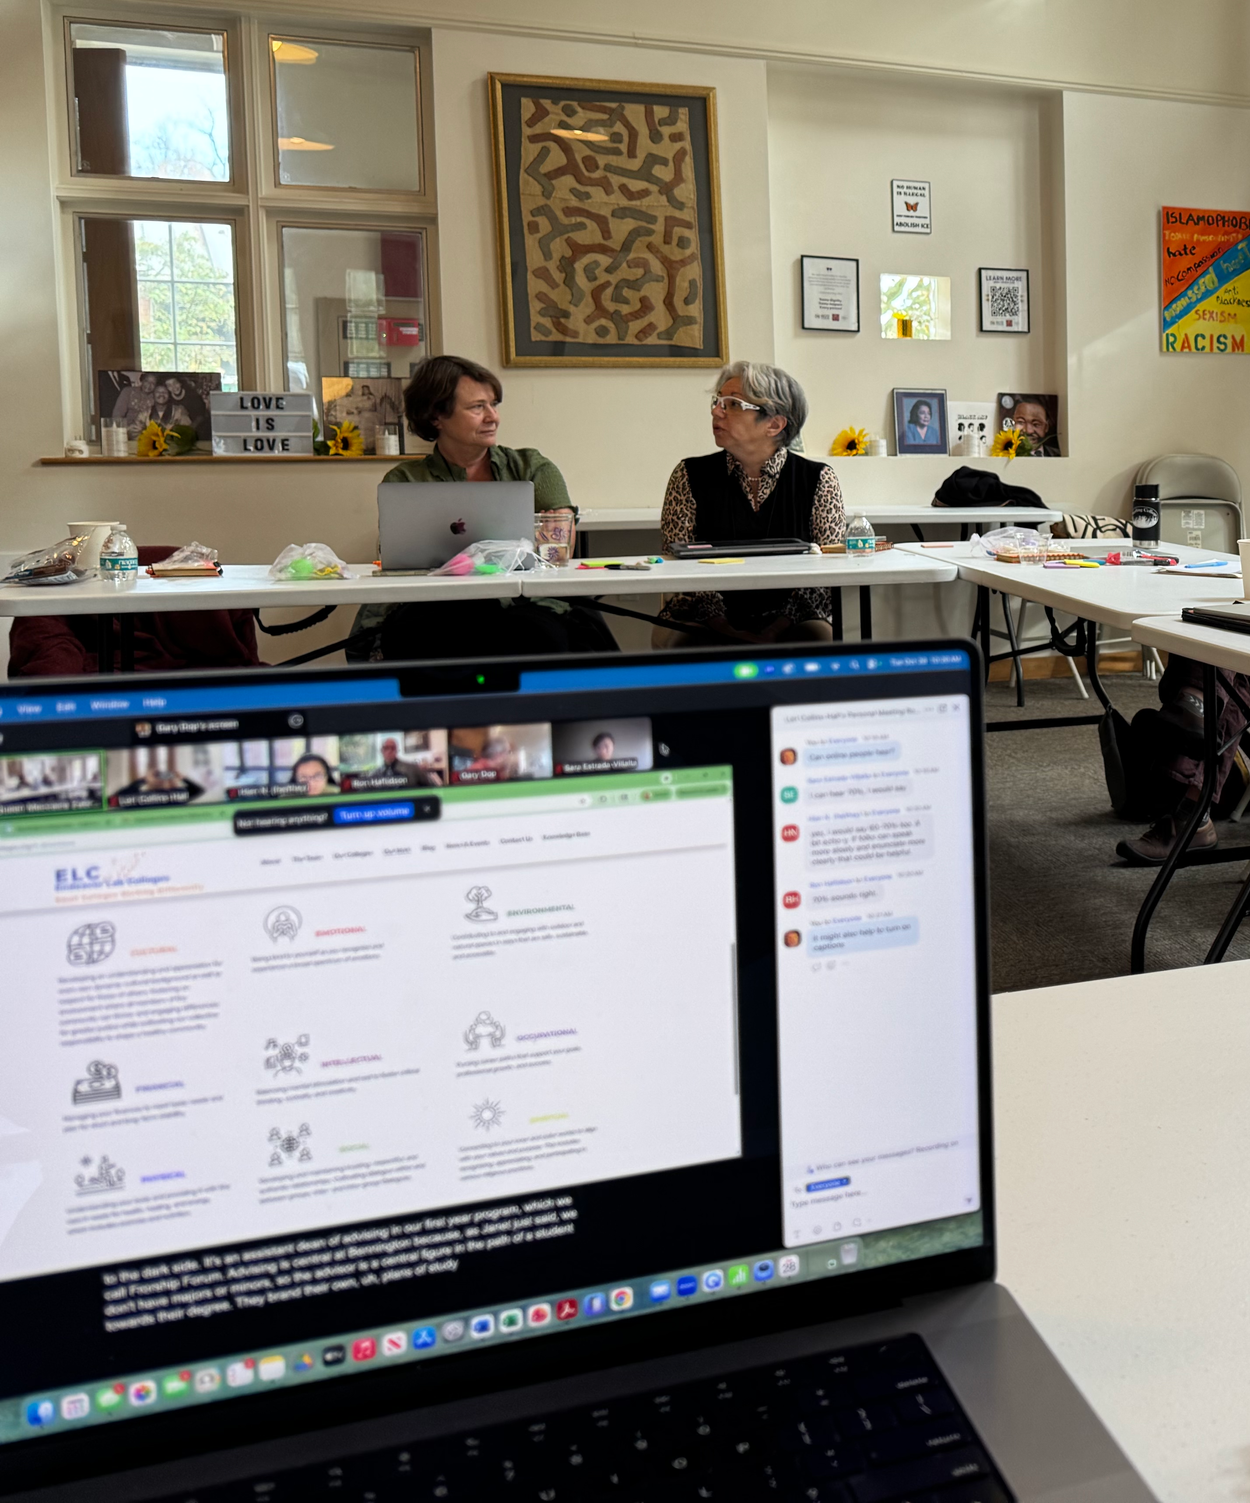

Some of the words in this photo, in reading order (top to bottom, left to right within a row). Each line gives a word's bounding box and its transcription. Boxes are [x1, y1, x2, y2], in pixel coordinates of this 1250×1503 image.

[1166, 244, 1196, 258] hate
[1194, 309, 1237, 324] SEXISM
[1165, 333, 1245, 352] RACISM
[240, 396, 285, 410] LOVE
[256, 418, 275, 431] IS
[243, 438, 290, 452] LOVE
[90, 699, 130, 711] Window
[143, 697, 167, 708] Help
[461, 771, 478, 781] Gary
[480, 770, 497, 779] Dop
[56, 866, 101, 883] ELC
